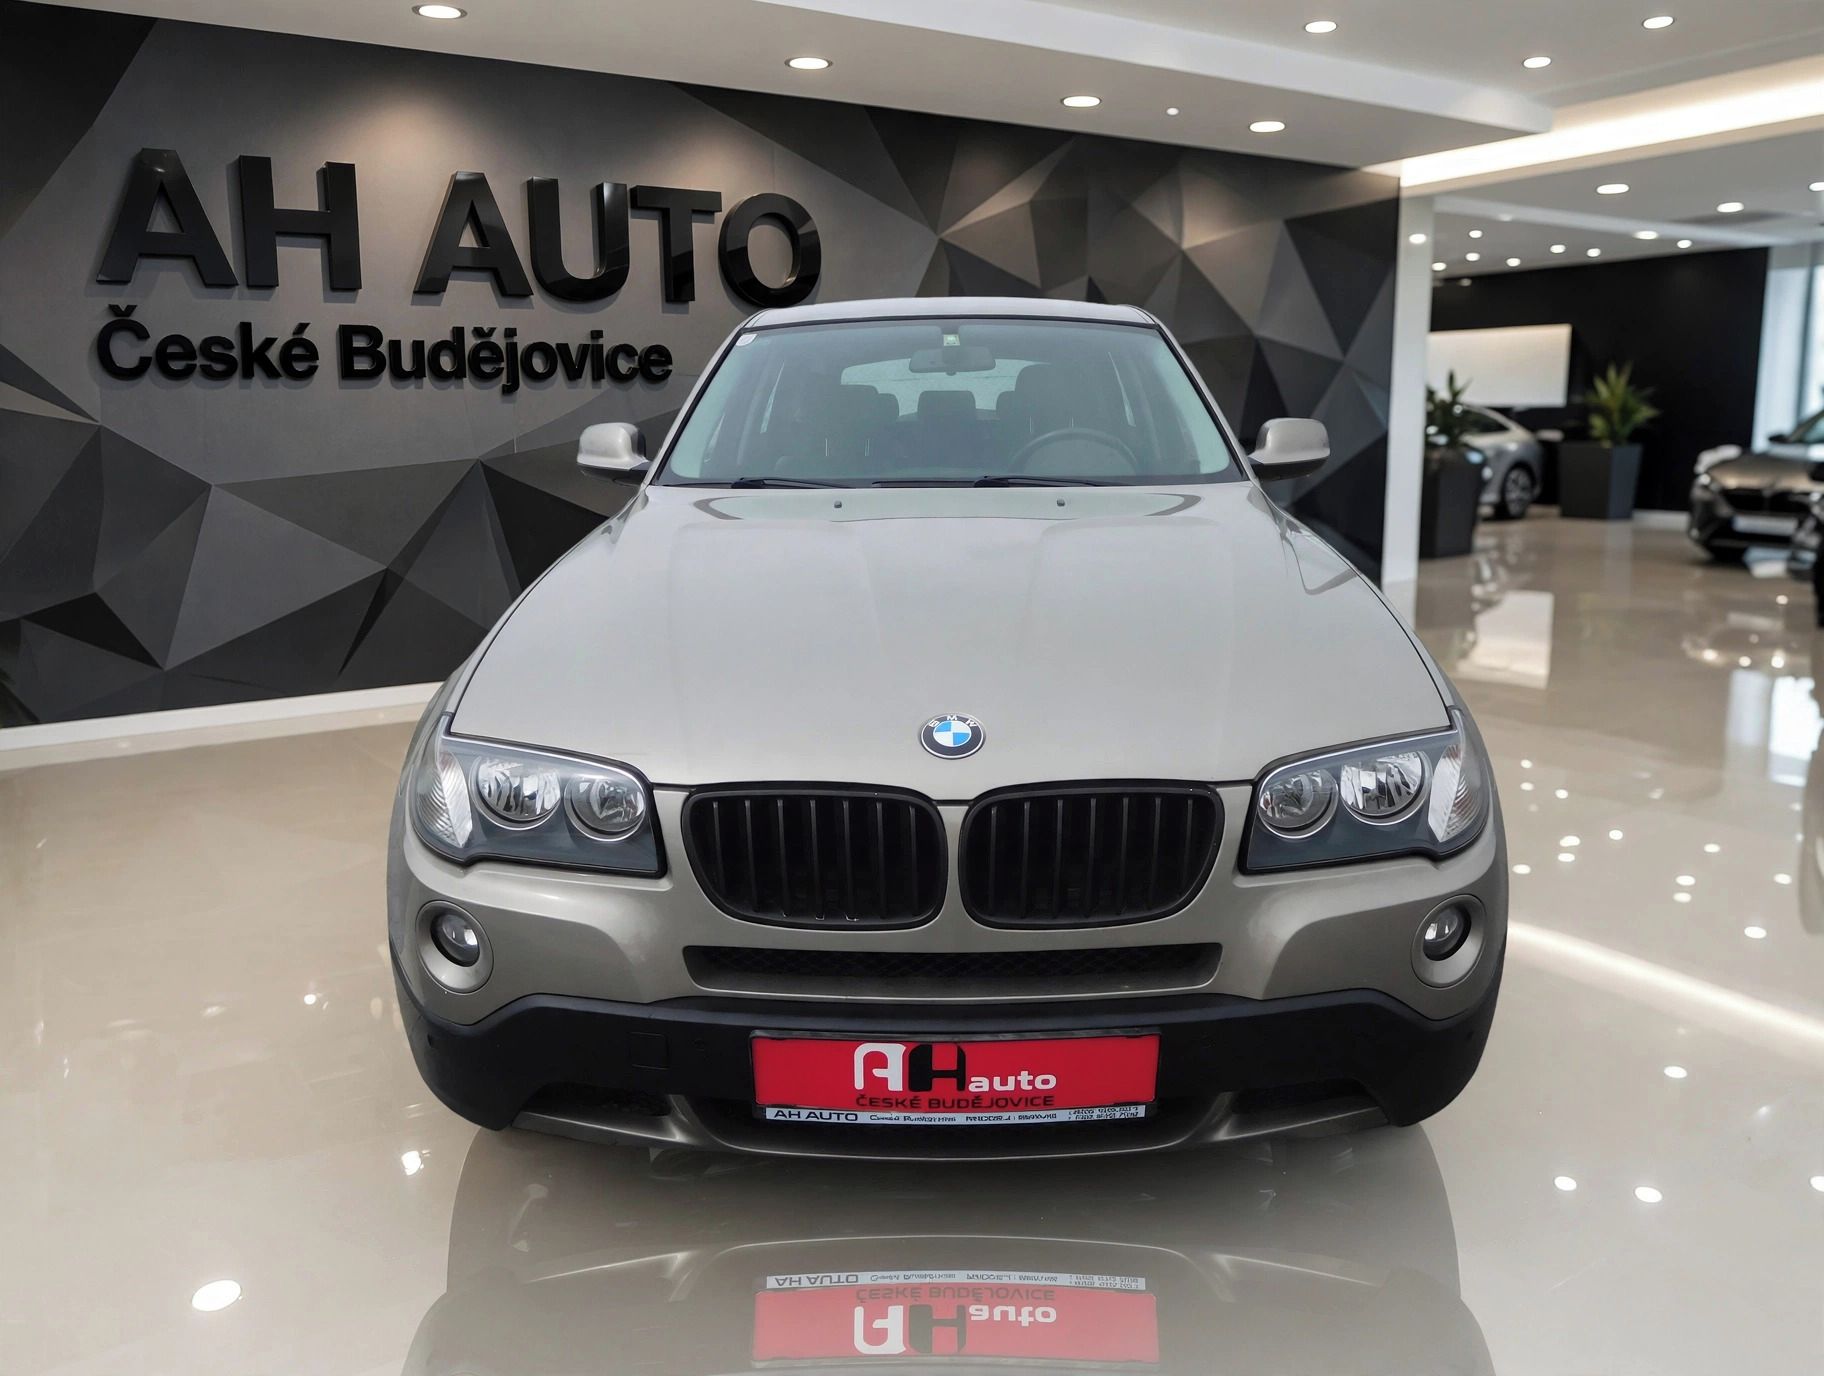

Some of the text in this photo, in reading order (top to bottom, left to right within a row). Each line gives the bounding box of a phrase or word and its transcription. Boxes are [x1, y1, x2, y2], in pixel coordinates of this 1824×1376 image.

[96, 148, 822, 307] AH AUTO
[96, 304, 673, 394] České Budějovice
[774, 1109, 801, 1119] AH
[806, 1111, 858, 1121] AUTO
[856, 1094, 1055, 1109] ČESKÉ BUDĚJOVICE
